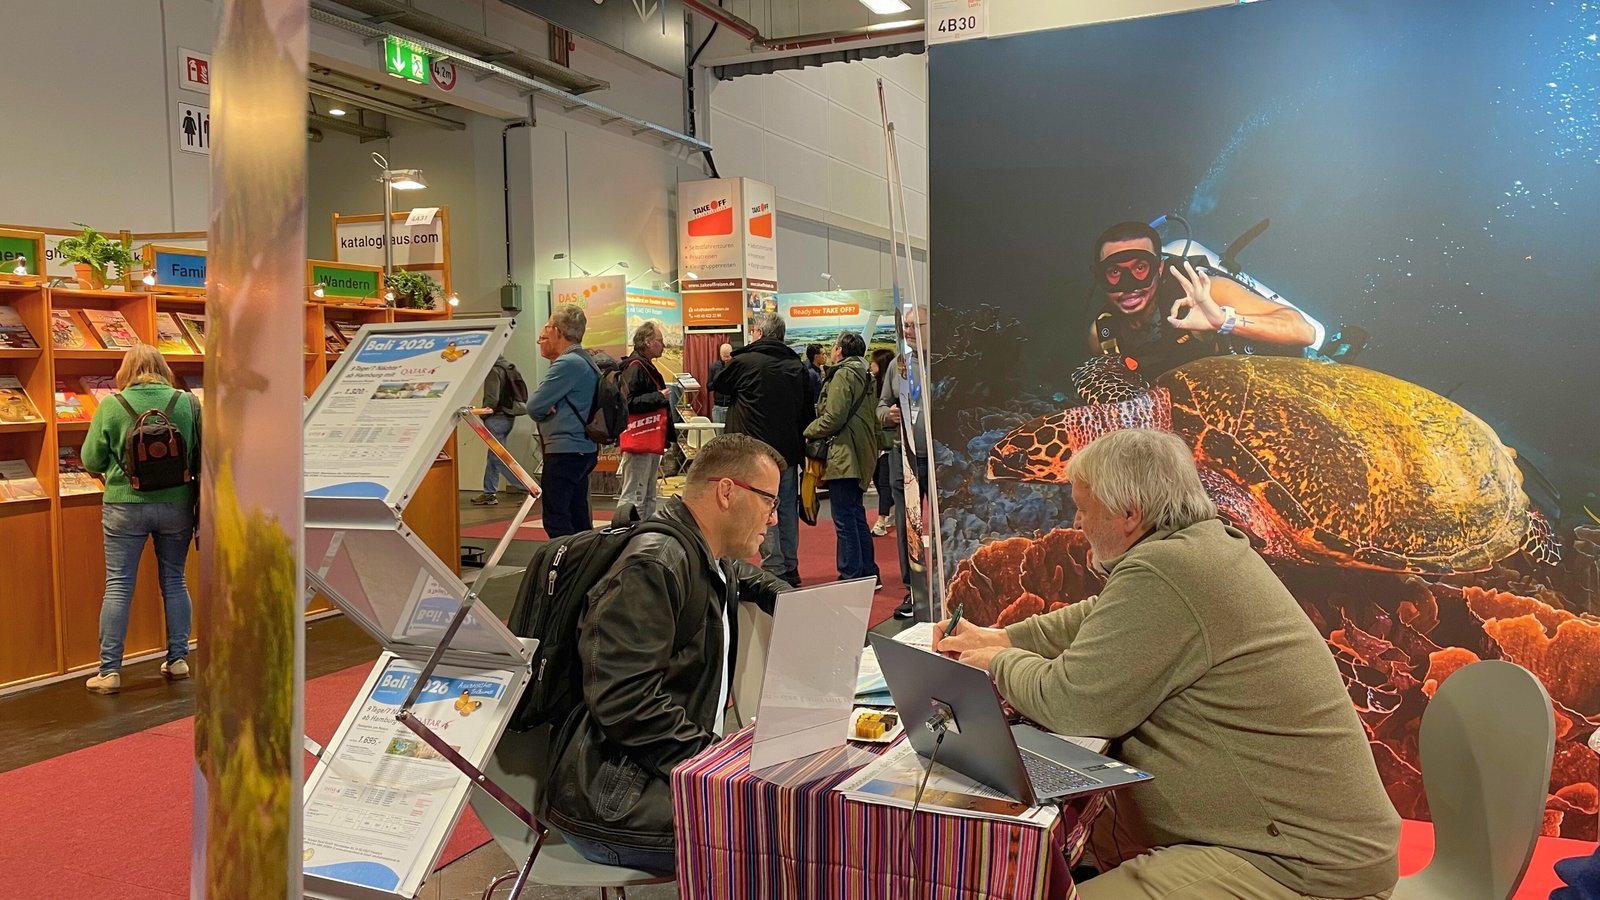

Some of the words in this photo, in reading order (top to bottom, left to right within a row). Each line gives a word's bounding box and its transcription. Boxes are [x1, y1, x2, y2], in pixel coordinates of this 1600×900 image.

[938, 16, 976, 33] 4B30
[320, 275, 370, 290] Wandern
[559, 293, 577, 303] DAS
[365, 340, 396, 351] Bali
[395, 338, 436, 350] 2026
[381, 674, 411, 689] Bali
[370, 715, 397, 726] Hamburg
